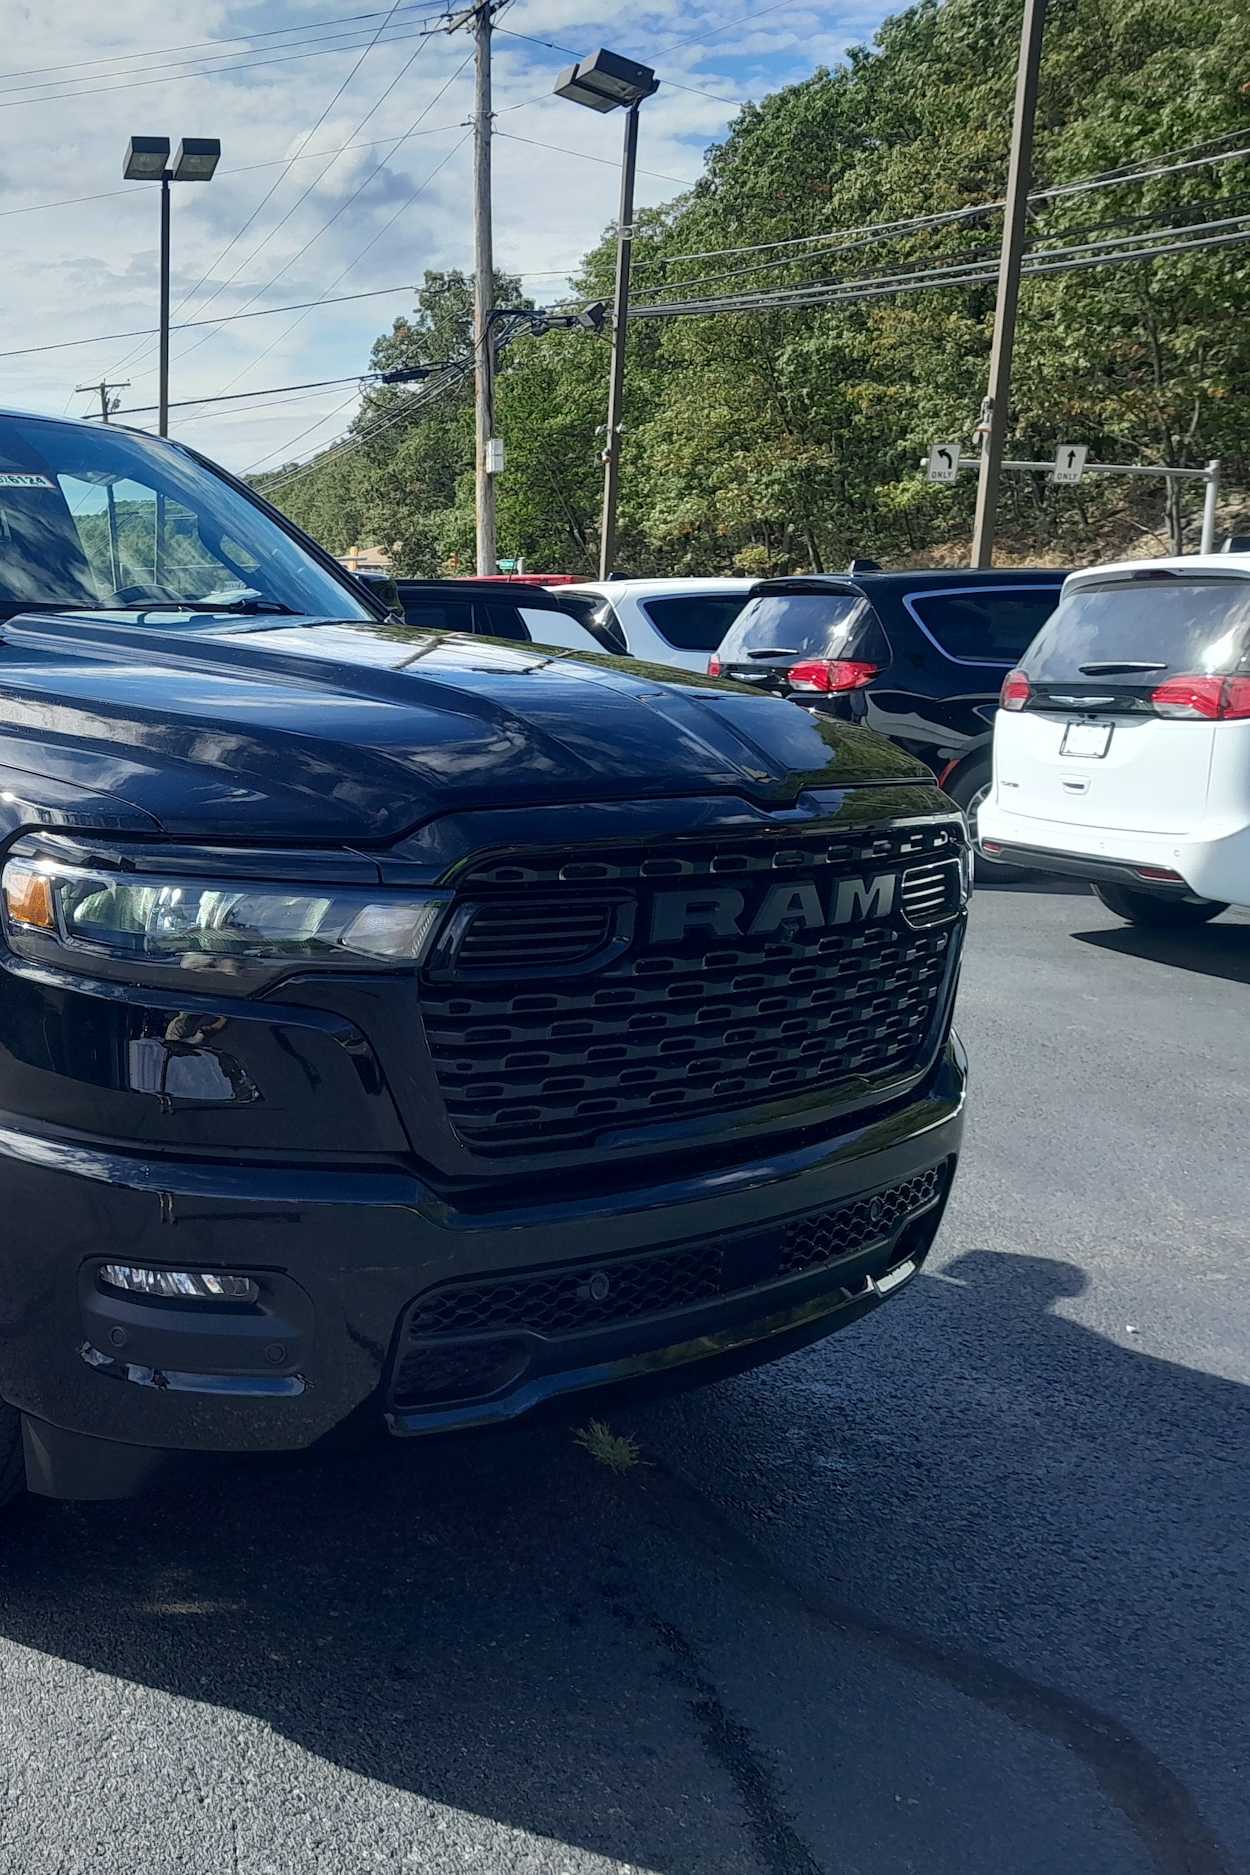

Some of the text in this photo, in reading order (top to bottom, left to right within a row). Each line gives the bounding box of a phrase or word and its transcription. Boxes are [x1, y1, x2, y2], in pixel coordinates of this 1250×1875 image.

[931, 471, 953, 479] ONLY
[1057, 472, 1078, 480] ONLY
[650, 872, 897, 944] RAM
